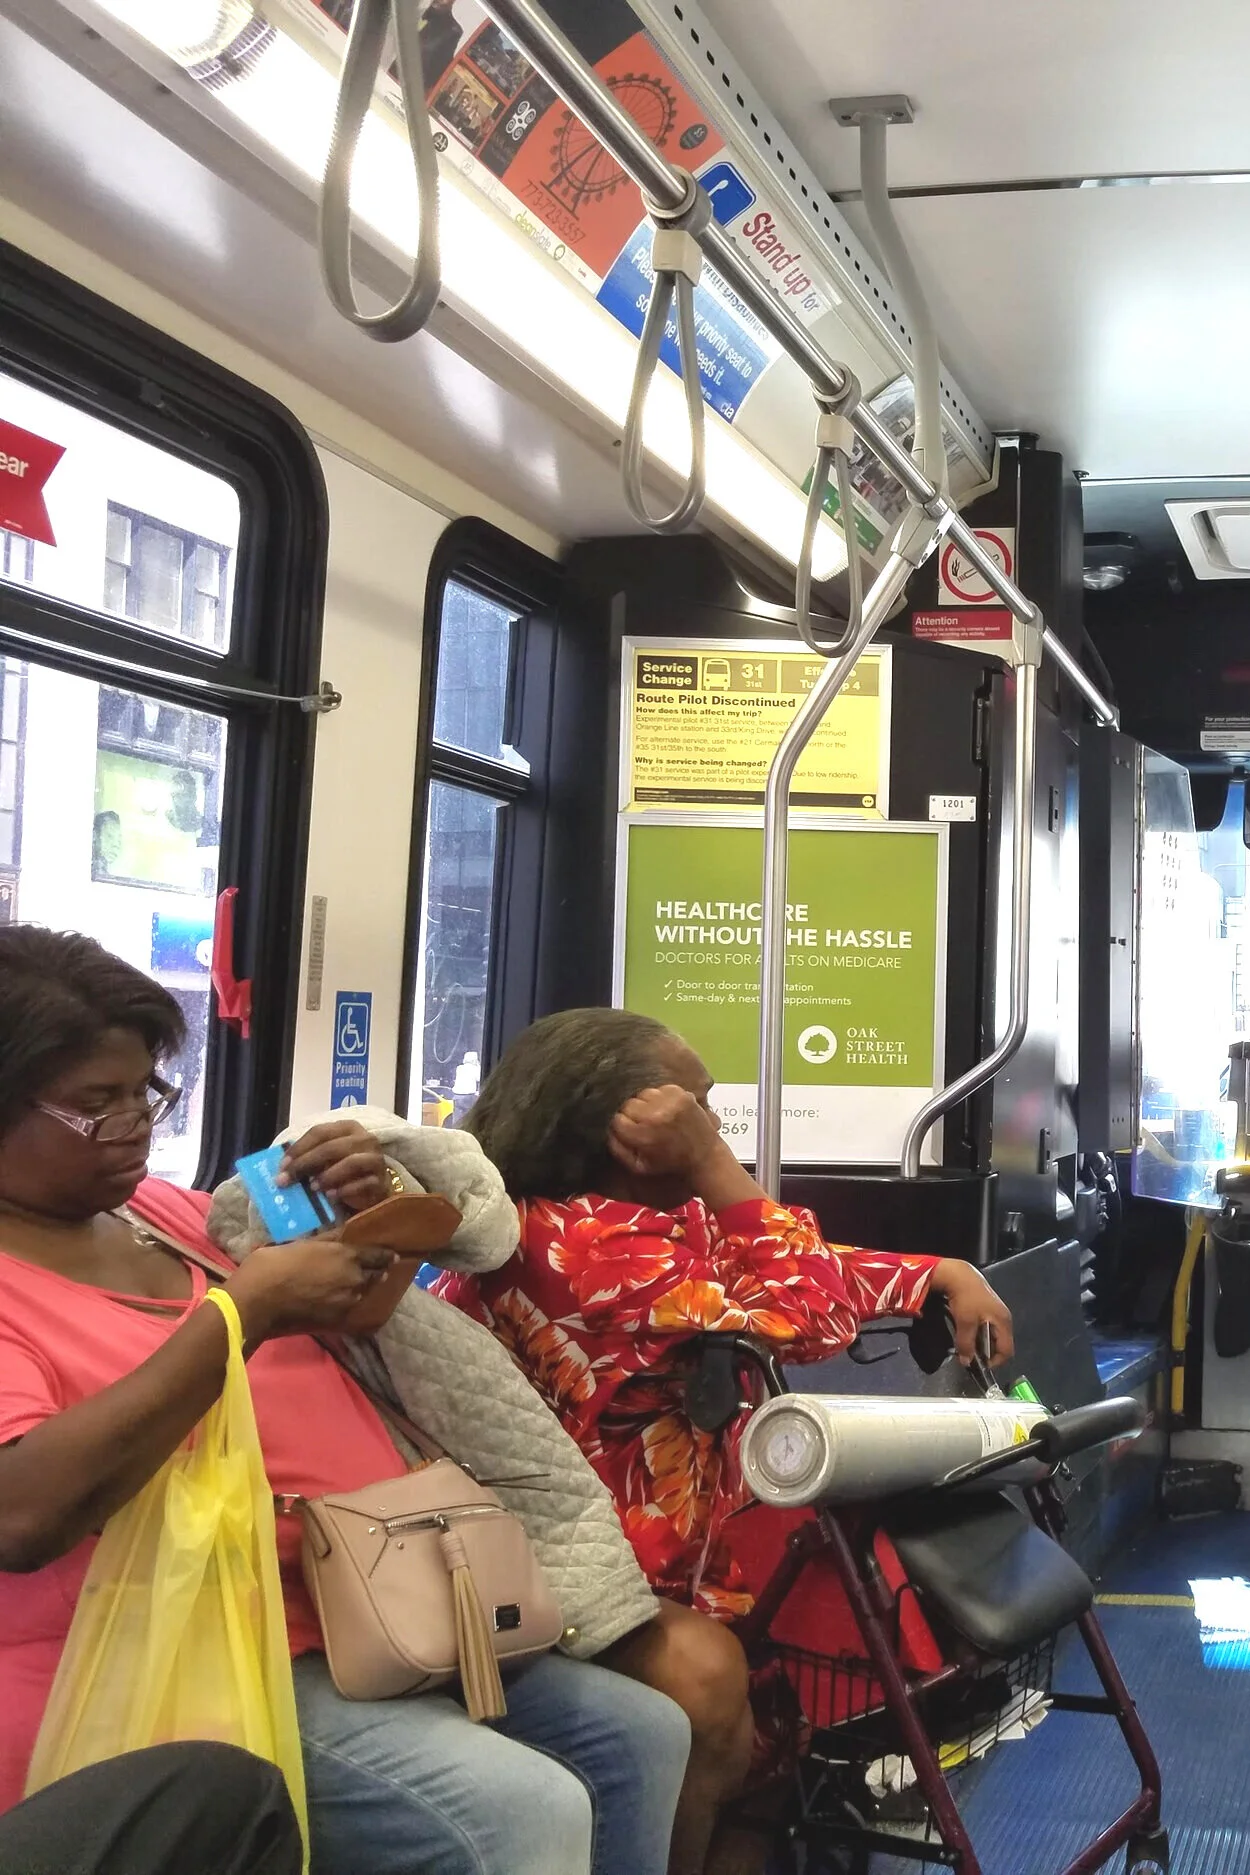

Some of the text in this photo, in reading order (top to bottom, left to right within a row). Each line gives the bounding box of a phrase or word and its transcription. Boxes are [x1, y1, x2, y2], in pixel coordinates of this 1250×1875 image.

[742, 212, 821, 312] Stand up for
[631, 247, 657, 284] Pleas
[696, 321, 729, 357] priority
[725, 348, 747, 371] seat
[741, 361, 752, 378] to
[720, 402, 735, 420] cta
[915, 616, 958, 626] Attention
[642, 662, 765, 679] Service 31
[642, 674, 763, 688] Change 31st
[852, 681, 861, 690] 4
[637, 693, 796, 708] Route Pilot Discontinued
[636, 715, 681, 723] Experimental
[743, 710, 762, 718] trip?
[636, 723, 662, 732] Orange
[721, 726, 755, 735] 33rd/King
[651, 744, 683, 752] 31st/35th
[943, 799, 964, 808] 1201
[656, 901, 809, 922] HEALTHCRE
[655, 925, 912, 949] WITHOUT HE HASSLE
[655, 952, 902, 969] DOCTORS FOR ALTS ON MEDICARE
[676, 980, 741, 990] Door to door
[676, 993, 726, 1004] Same-day
[727, 994, 736, 1003] &
[784, 996, 852, 1006] appointments
[846, 1027, 878, 1038] OAK
[846, 1041, 905, 1052] STREET
[846, 1053, 908, 1065] HEALTH
[336, 1061, 366, 1076] Priority
[336, 1076, 365, 1090] seating
[723, 1106, 738, 1117] to
[781, 1108, 820, 1118] more:
